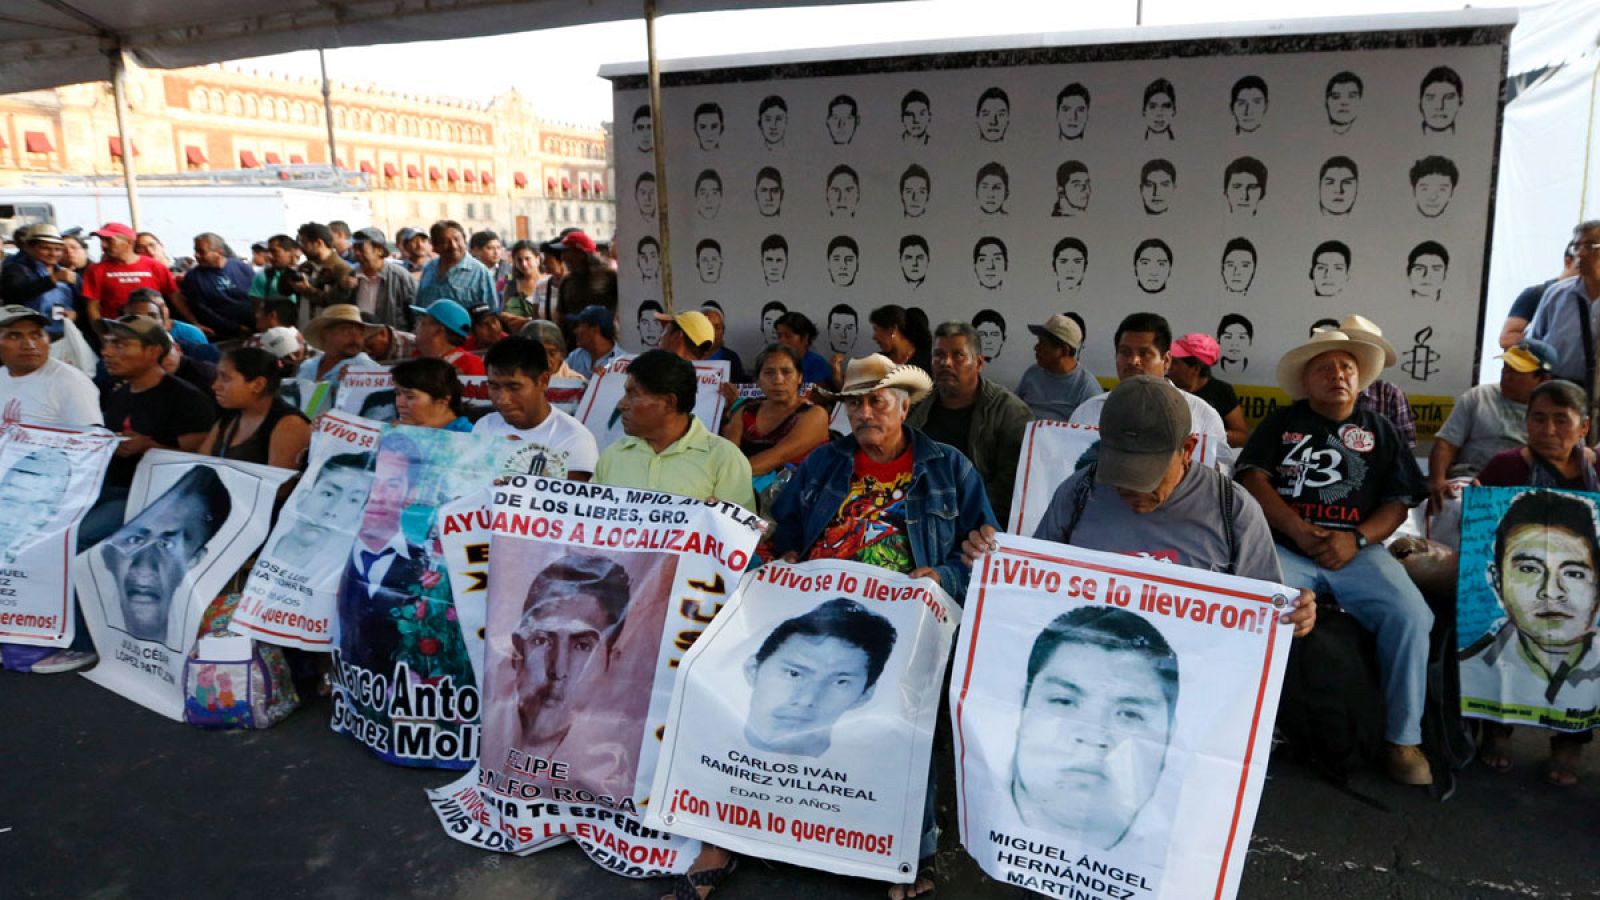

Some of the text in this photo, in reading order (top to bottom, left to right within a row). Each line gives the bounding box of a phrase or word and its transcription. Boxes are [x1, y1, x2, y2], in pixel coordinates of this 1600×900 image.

[1240, 396, 1277, 418] IDA
[359, 435, 375, 449] se
[1281, 434, 1342, 498] 43
[494, 492, 689, 526] DE LOS LIBRES, GRO.
[535, 479, 619, 505] OCOAPA,
[626, 491, 673, 505] MPIO.
[568, 523, 585, 544] A
[592, 525, 748, 572] LOCALIZARLO
[757, 565, 948, 623] ¡Vivo se lo llevaron!
[991, 558, 1268, 635] ¡Vivo se lo llevaron!
[331, 649, 481, 721] Marco Anto
[332, 689, 389, 752] Gomez
[701, 755, 877, 801] RAMÍREZ VILLAREAL
[728, 750, 847, 783] CARLOS IVÁN
[526, 803, 560, 818] TE
[670, 789, 894, 857] ¡Con VIDA lo queremos!
[730, 786, 841, 813] EDAD 20 AÑOS
[543, 822, 677, 868] LLEVARON!
[989, 830, 1152, 892] MIGUEL ÁNGEL
[997, 851, 1135, 900] HERNÁNDEZ
